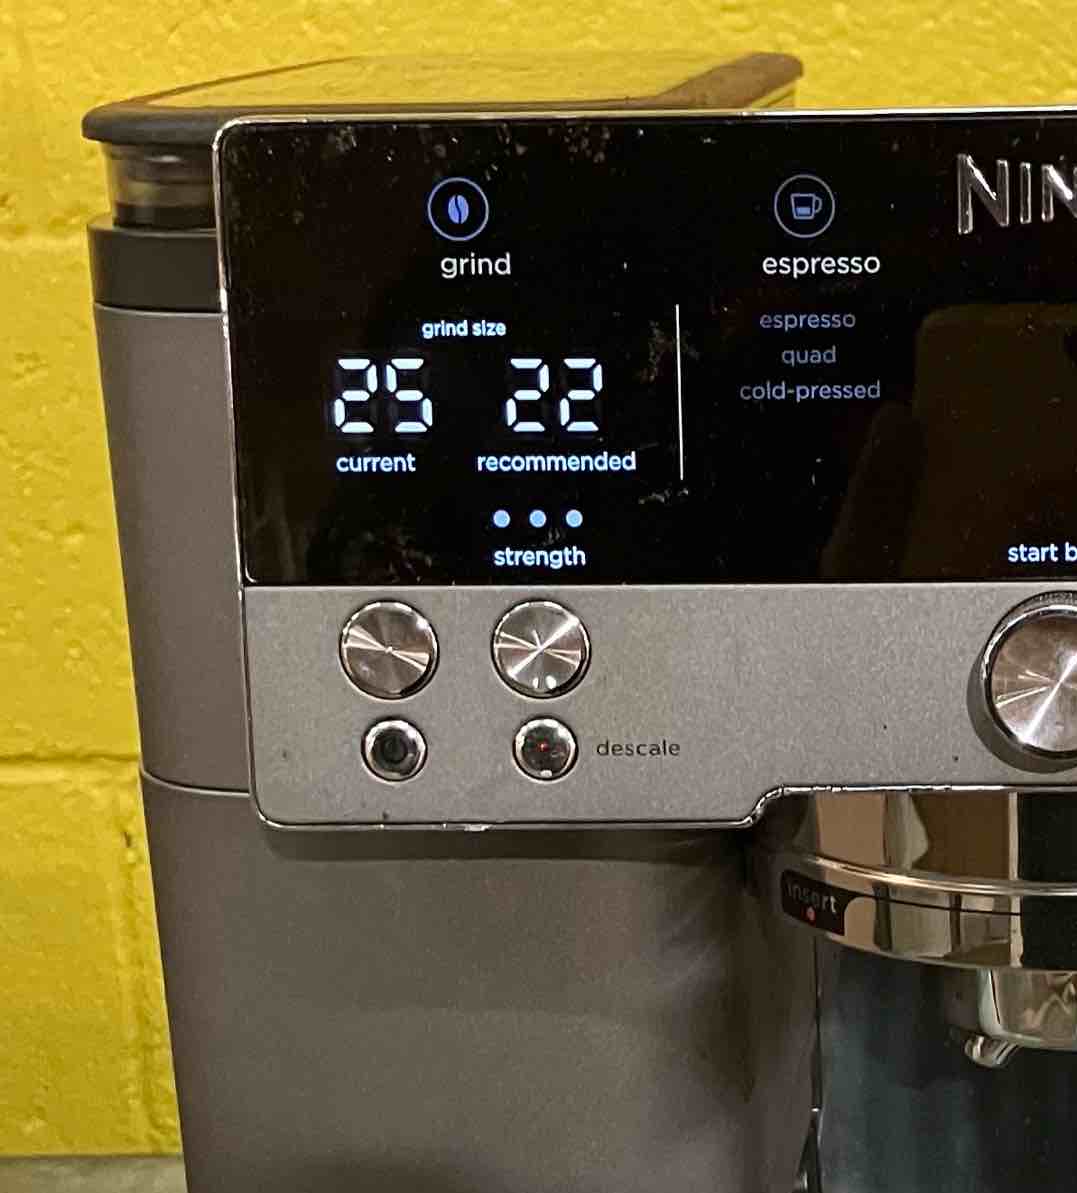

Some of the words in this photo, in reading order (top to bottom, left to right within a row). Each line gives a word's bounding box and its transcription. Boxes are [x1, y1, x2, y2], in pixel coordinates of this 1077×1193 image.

[441, 253, 511, 278] grind
[763, 254, 880, 278] espresso
[422, 320, 468, 339] grind
[472, 320, 506, 336] size
[760, 312, 855, 333] espresso
[782, 346, 836, 366] quad
[334, 359, 432, 433] 25
[506, 358, 602, 432] 22
[741, 380, 880, 402] cold-pressed
[336, 454, 416, 472] current
[478, 451, 636, 471] recommended
[494, 546, 586, 569] strength
[1008, 544, 1058, 562] start
[596, 739, 681, 756] descale
